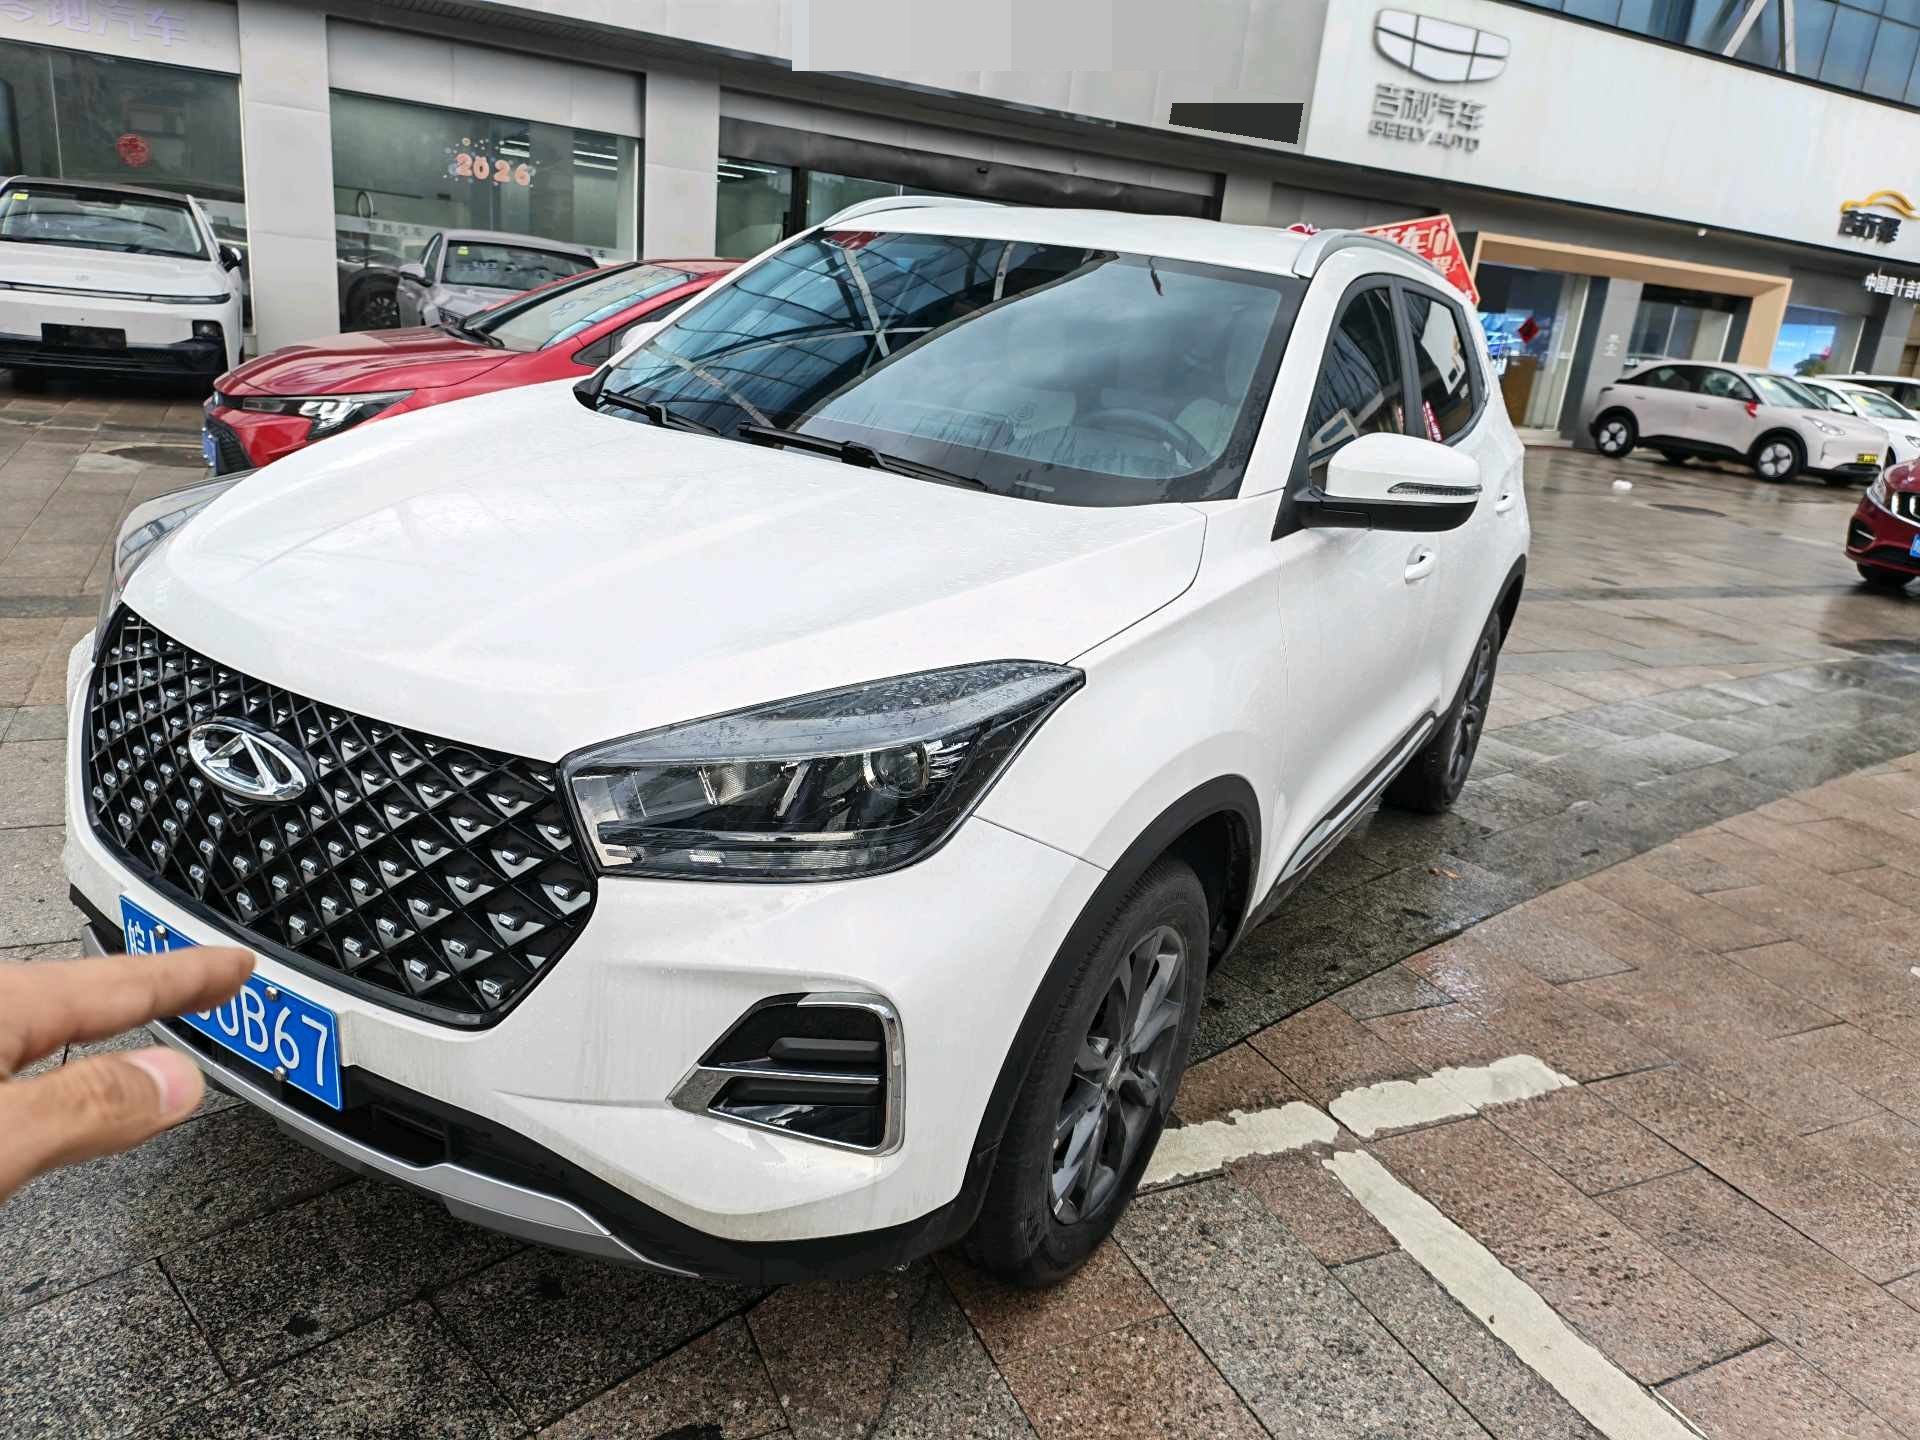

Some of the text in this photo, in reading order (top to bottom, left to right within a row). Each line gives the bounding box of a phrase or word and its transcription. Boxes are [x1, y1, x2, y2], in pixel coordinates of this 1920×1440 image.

[1372, 83, 1486, 130] 吉利汽车
[1367, 118, 1480, 153] GEELY AUTO
[455, 153, 531, 186] 2026
